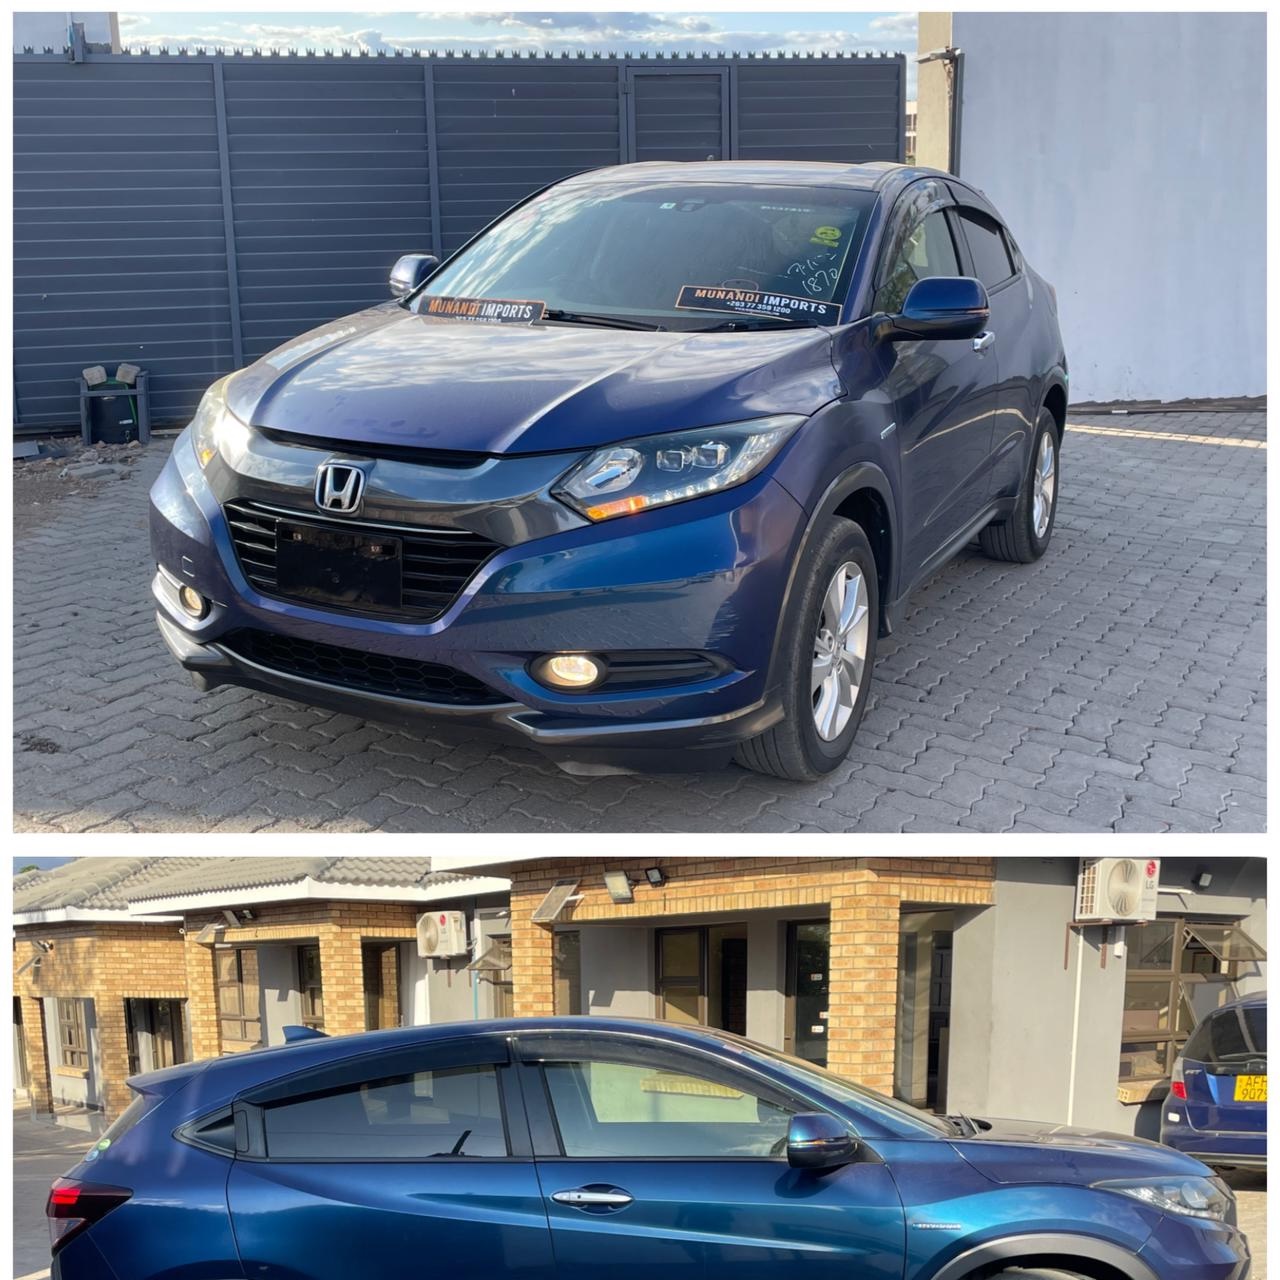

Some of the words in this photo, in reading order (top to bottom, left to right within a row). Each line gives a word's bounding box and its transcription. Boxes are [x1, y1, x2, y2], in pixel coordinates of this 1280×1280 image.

[802, 267, 838, 296] 1870
[428, 298, 480, 316] MUNANDI
[481, 302, 533, 318] IMPORTS
[694, 289, 760, 302] MUNANDI
[763, 295, 827, 315] IMPORTS
